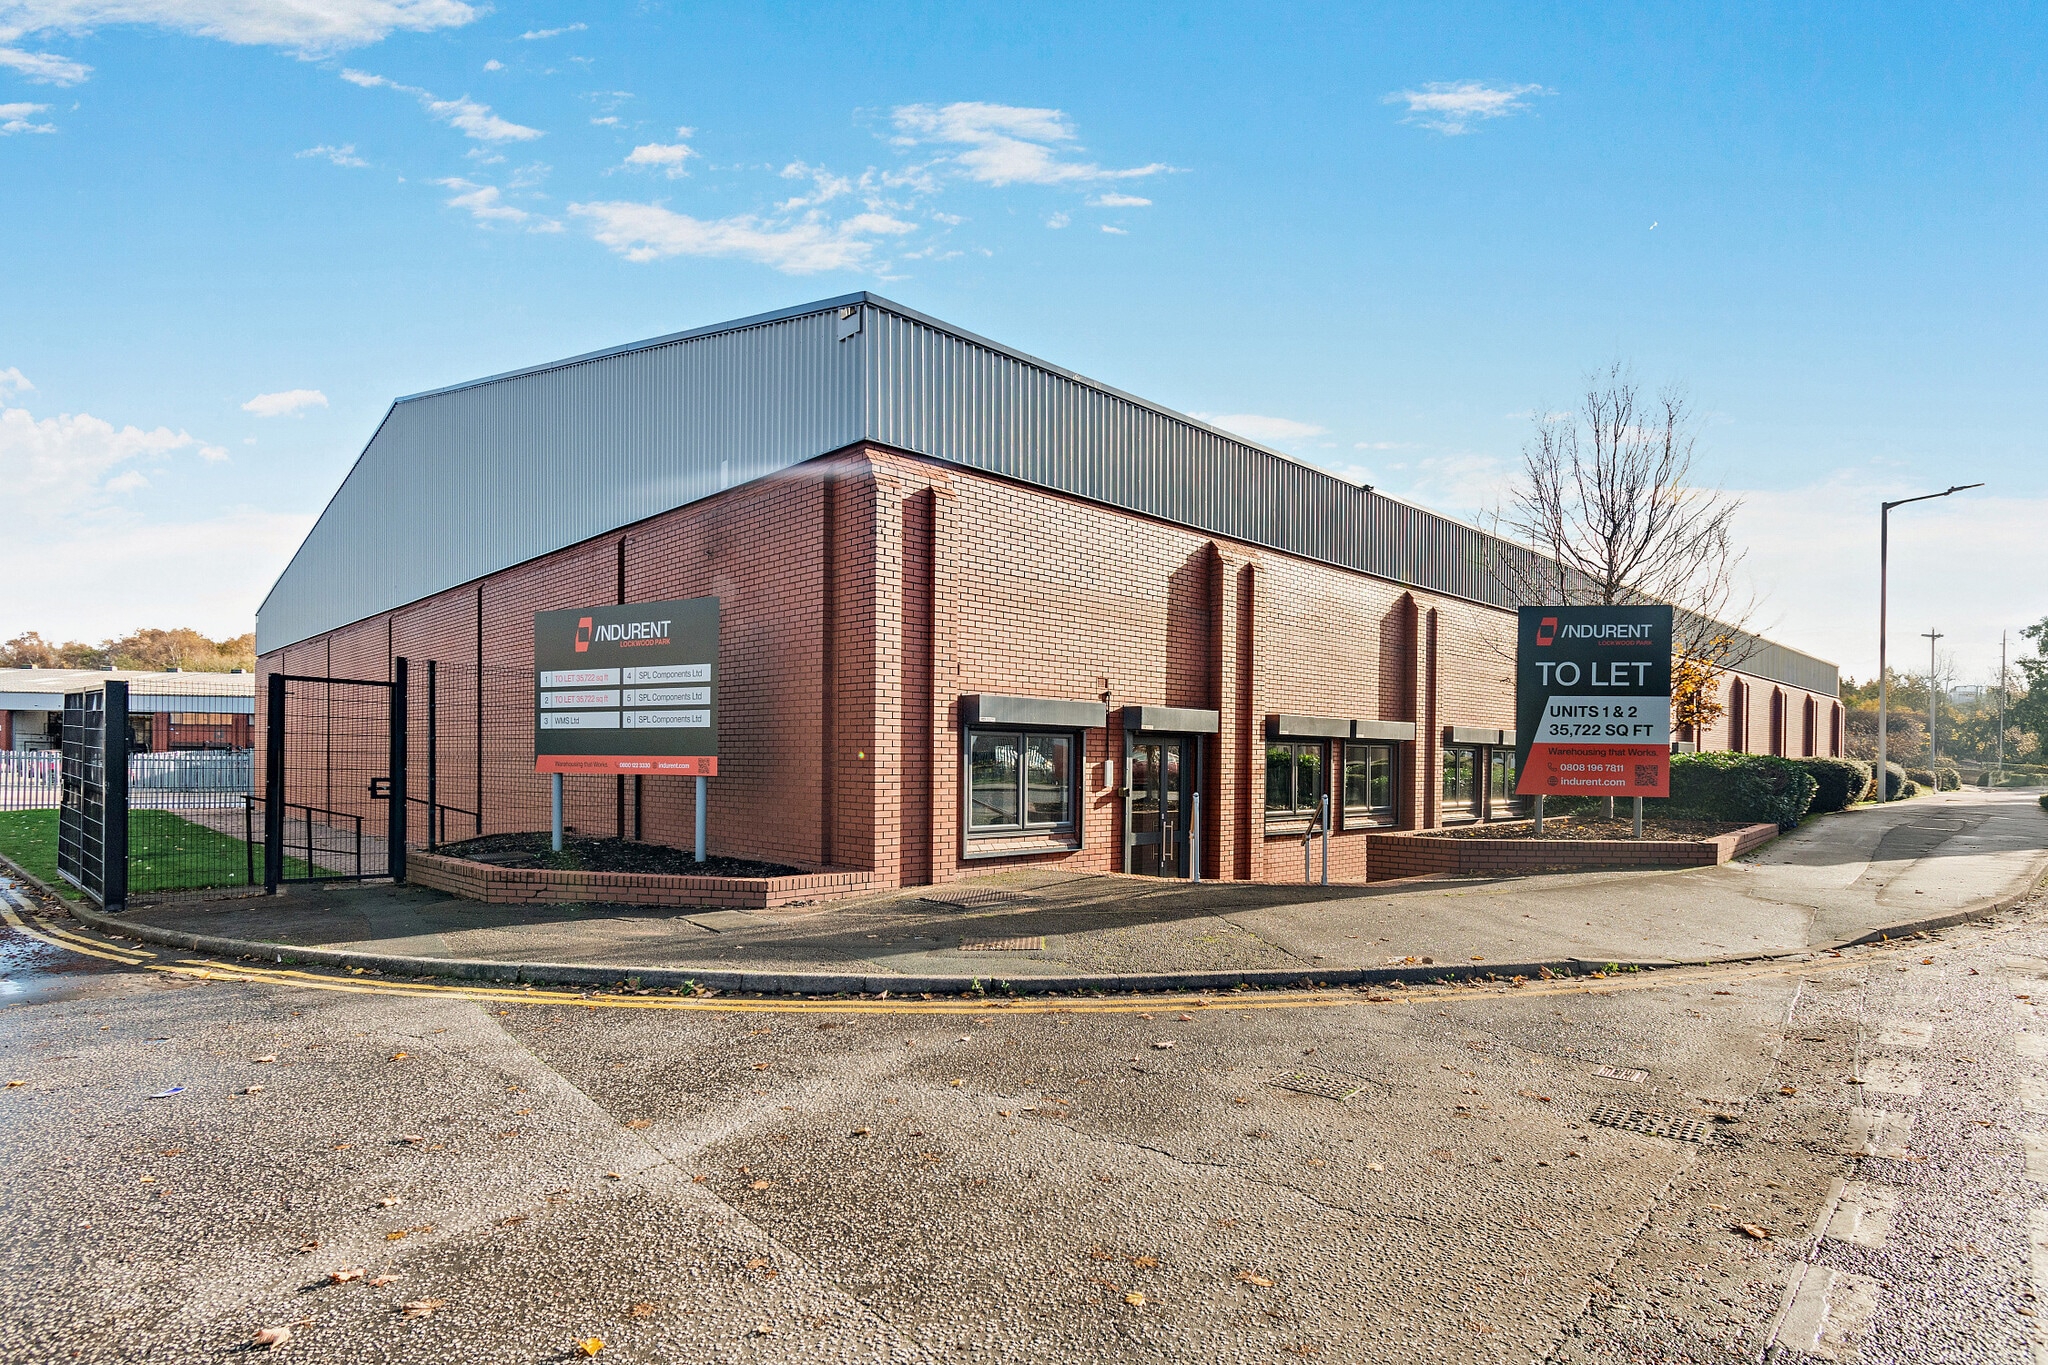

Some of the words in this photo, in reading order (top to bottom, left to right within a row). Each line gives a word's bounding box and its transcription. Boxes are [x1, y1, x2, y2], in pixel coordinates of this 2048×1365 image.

[620, 639, 654, 648] LOCKWOOD
[655, 637, 671, 646] PARK
[555, 674, 563, 683] TO
[564, 674, 575, 683] LET
[596, 675, 603, 683] sq
[604, 673, 609, 681] ft
[639, 671, 651, 680] SPL
[652, 669, 691, 680] Components
[692, 668, 702, 678] Ltd
[1535, 661, 1580, 687] TO
[1591, 661, 1653, 687] LET
[544, 696, 549, 704] 2
[555, 695, 563, 704] TO
[564, 695, 575, 704] LET
[596, 696, 603, 704] sq
[604, 694, 609, 702] ft
[627, 694, 632, 702] 5
[639, 693, 651, 702] SPL
[652, 692, 691, 702] Components
[692, 691, 702, 701] Ltd
[1549, 705, 1599, 718] UNITS
[1602, 705, 1609, 718] 1
[1612, 705, 1624, 718] &
[1628, 705, 1638, 718] 2
[543, 717, 549, 725] 3
[555, 716, 570, 725] WMS
[571, 716, 580, 725] Ltd
[626, 715, 632, 724] 6
[639, 715, 651, 724] SPL
[652, 715, 691, 725] Components
[692, 714, 702, 723] Ltd
[1549, 724, 1601, 738] 35,722
[1605, 724, 1629, 737] SQ
[1633, 724, 1654, 737] FT
[1548, 747, 1607, 758] Warehousing
[1608, 748, 1626, 757] that
[555, 761, 584, 769] Warehousing
[1560, 763, 1585, 772] 0808
[1587, 763, 1604, 772] 196
[1605, 763, 1625, 772] 7811
[1560, 776, 1626, 787] indurent.com
